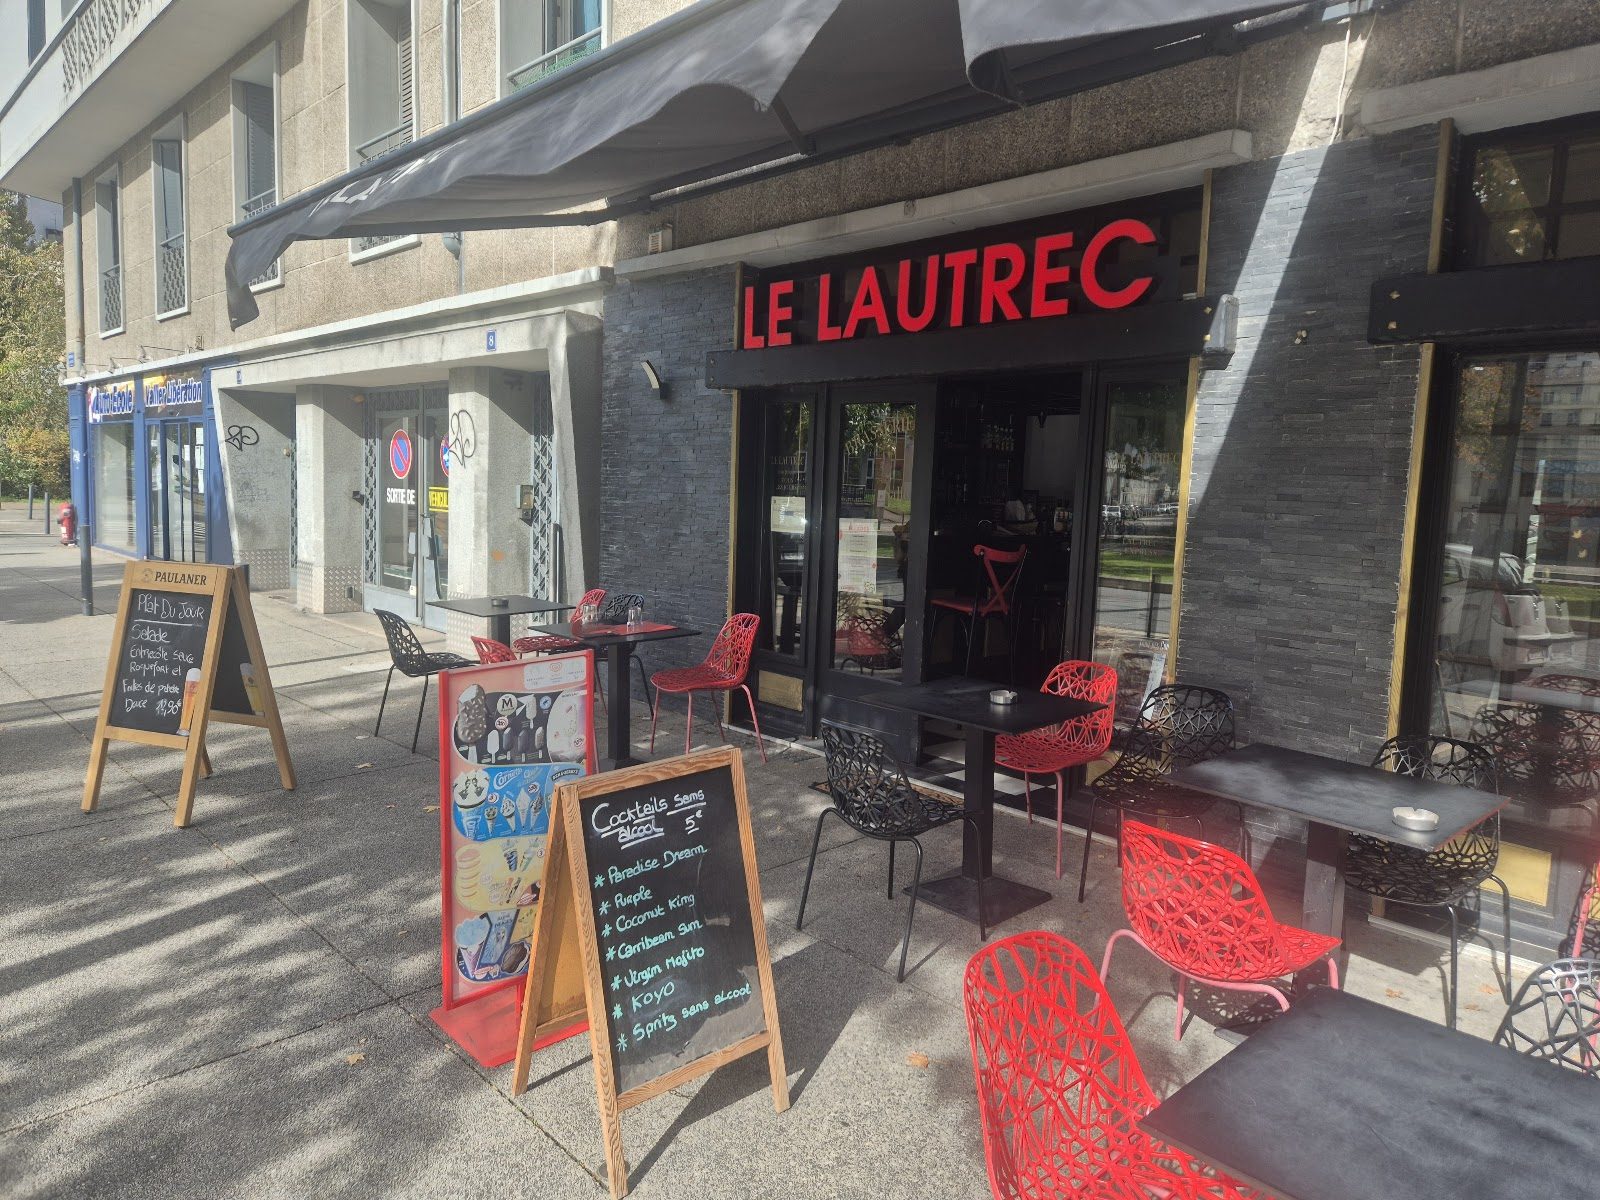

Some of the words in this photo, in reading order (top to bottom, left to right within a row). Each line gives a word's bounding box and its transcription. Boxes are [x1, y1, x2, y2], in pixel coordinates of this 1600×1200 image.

[743, 280, 794, 349] LE
[817, 218, 1157, 342] LAUTREC
[386, 487, 406, 504] SORTIE
[407, 489, 416, 505] DE
[155, 571, 207, 586] PAULANER
[144, 681, 156, 693] de
[591, 796, 668, 832] Cocktails
[618, 819, 664, 843] alcool
[608, 858, 660, 884] Paradise
[663, 844, 709, 869] Dream
[615, 904, 666, 932] Coconut
[668, 894, 695, 911] King
[678, 919, 703, 936] Sun
[624, 964, 662, 988] Virgin
[632, 1012, 678, 1041] Spritz
[714, 982, 752, 1005] alcool
